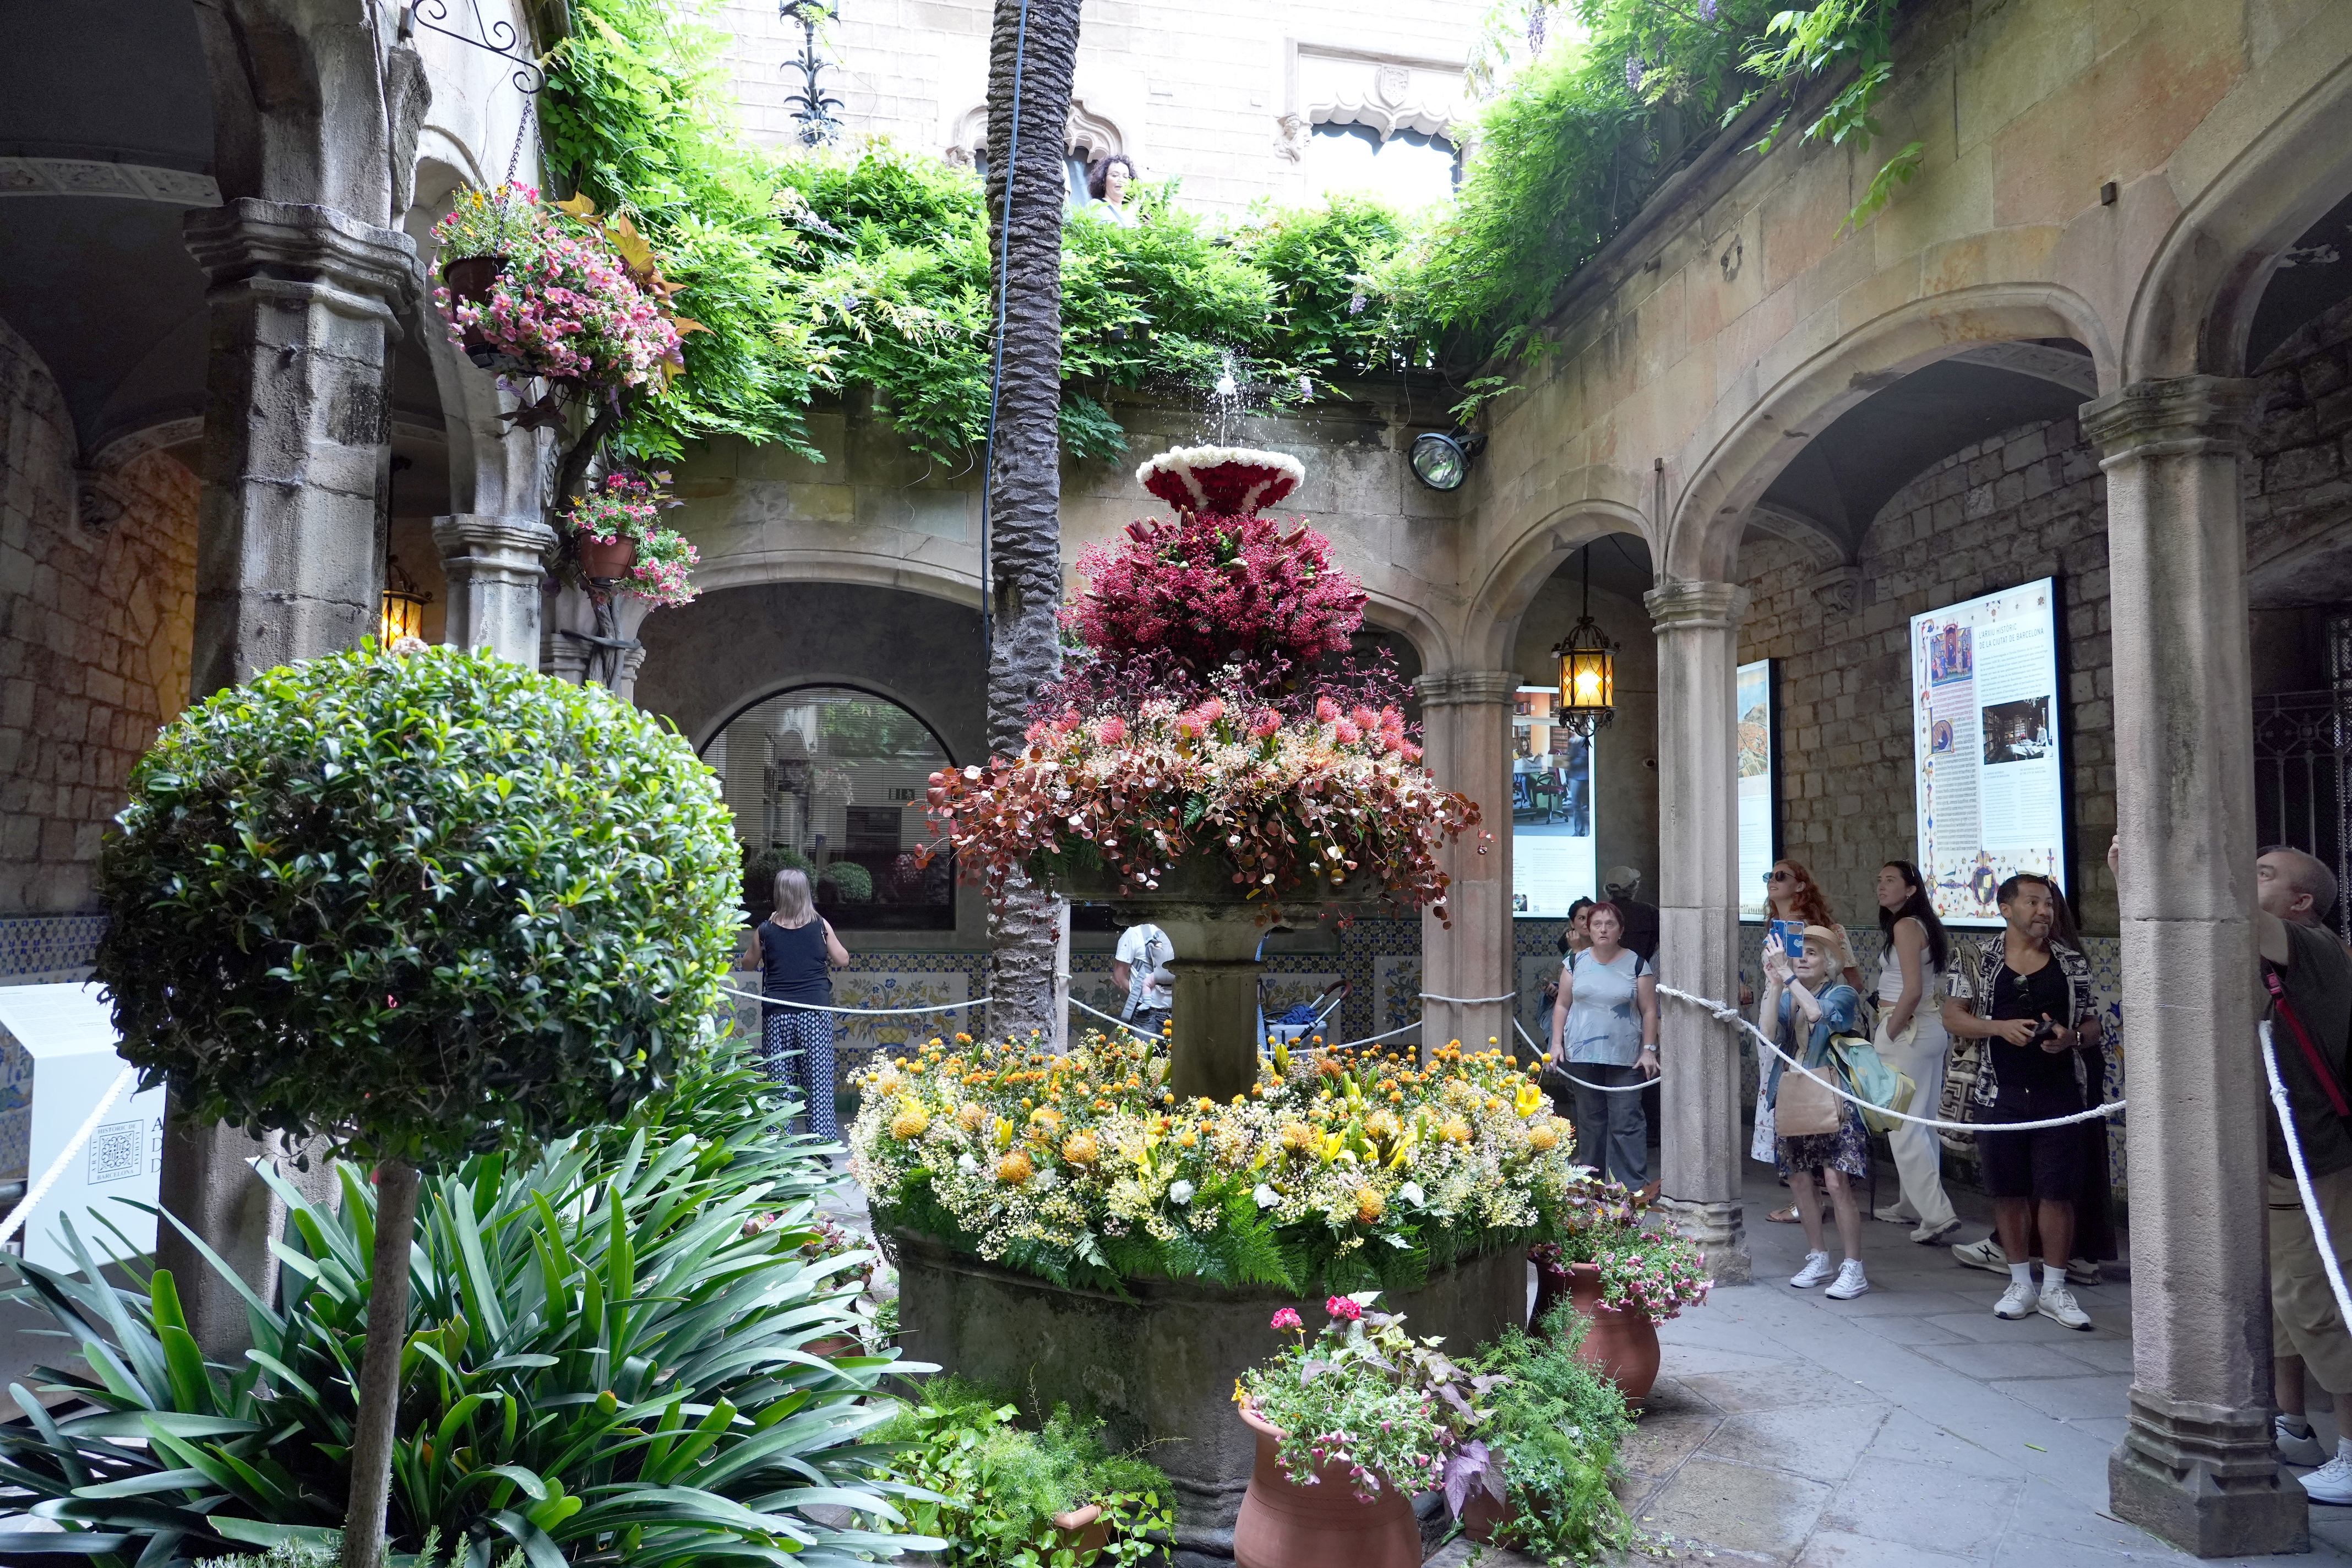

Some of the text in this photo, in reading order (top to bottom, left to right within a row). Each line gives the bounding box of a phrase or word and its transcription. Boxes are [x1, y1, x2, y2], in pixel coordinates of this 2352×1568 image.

[1979, 623, 2017, 639] L'ARXIU HISTÒRIC
[1992, 636, 2007, 646] CIUTAT
[2009, 634, 2015, 643] DE
[2016, 627, 2044, 640] BARCELONA
[97, 1169, 134, 1180] BARCELONA
